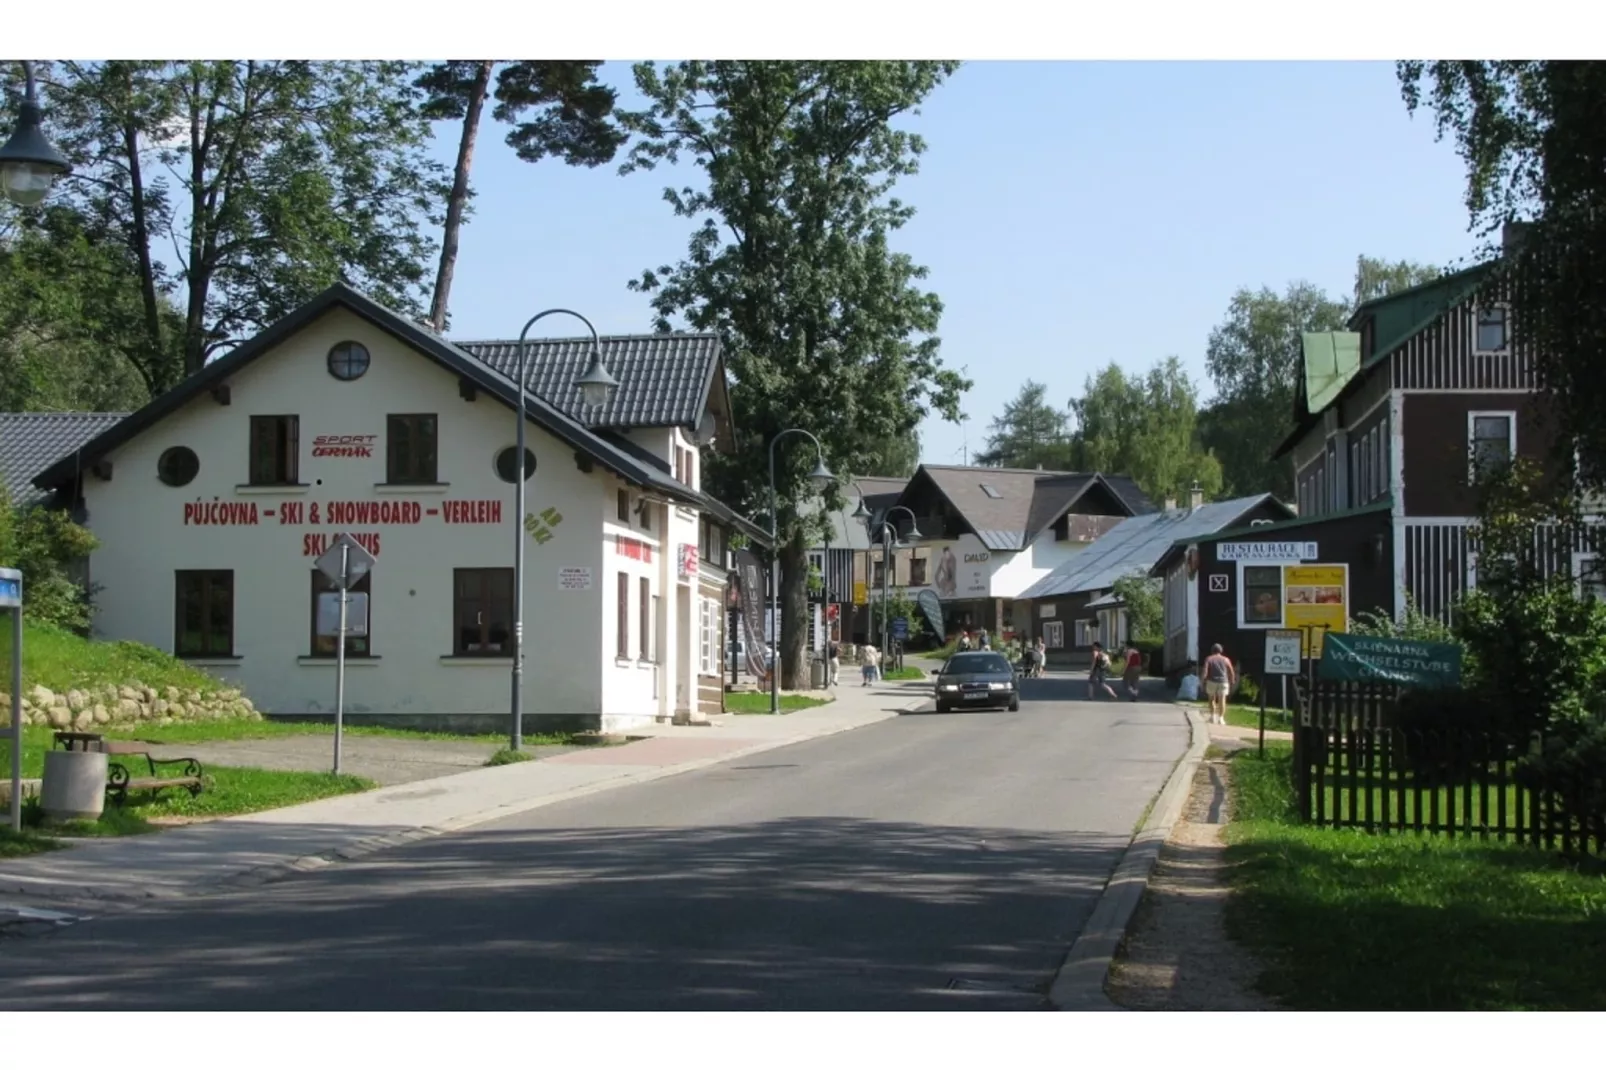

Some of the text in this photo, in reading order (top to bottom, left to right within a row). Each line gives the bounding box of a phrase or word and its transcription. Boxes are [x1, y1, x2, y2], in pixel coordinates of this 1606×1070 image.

[312, 434, 378, 446] SPORT
[280, 502, 303, 525] SKI
[309, 502, 321, 525] &
[327, 501, 421, 525] SNOWBOARD
[442, 500, 501, 524] VERLEIH
[303, 533, 326, 556] SKI
